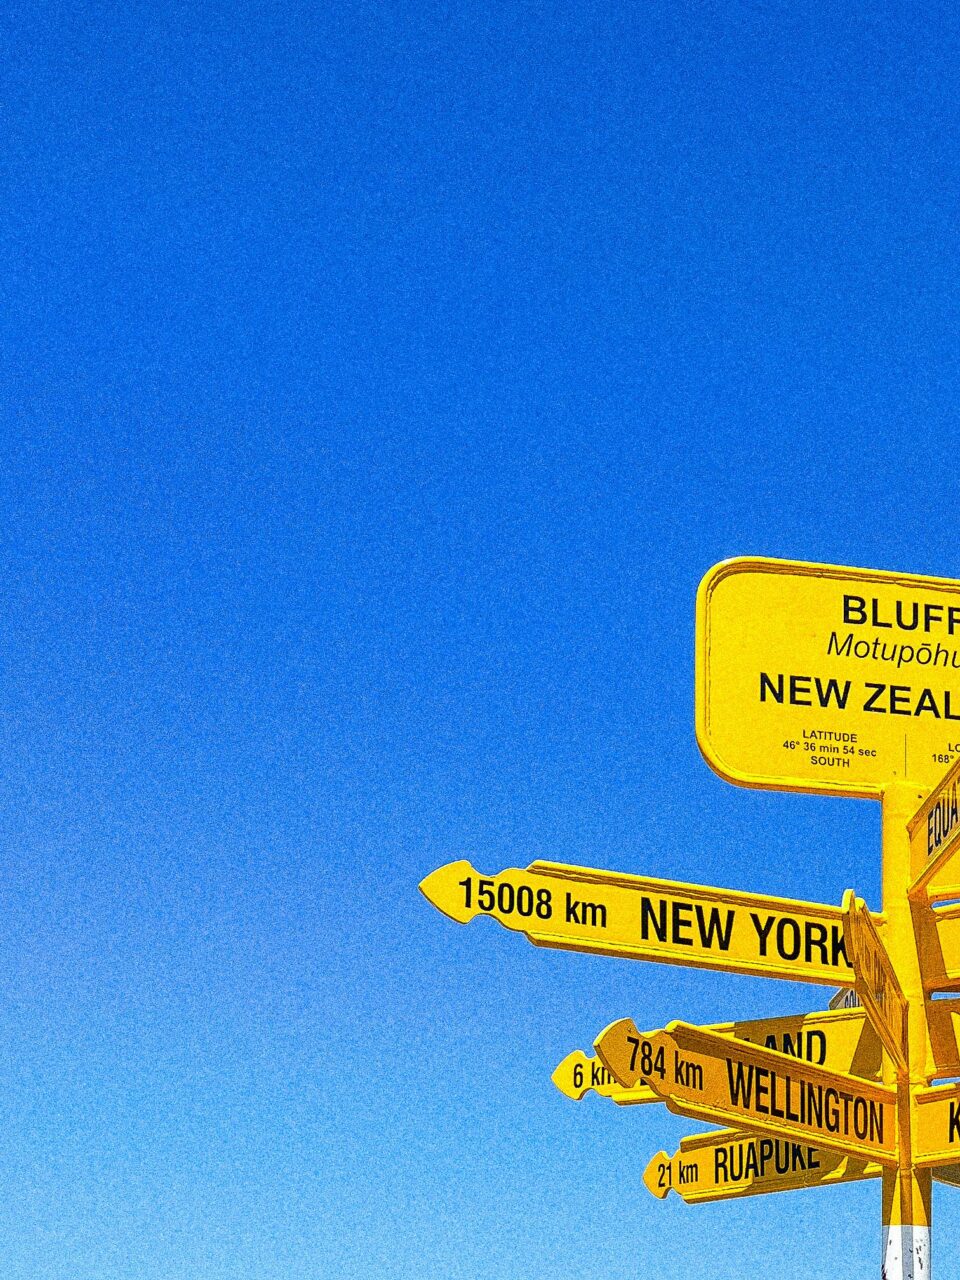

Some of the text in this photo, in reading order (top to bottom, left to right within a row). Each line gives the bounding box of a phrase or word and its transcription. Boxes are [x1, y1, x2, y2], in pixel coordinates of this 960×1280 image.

[759, 672, 852, 709] NEW
[783, 740, 877, 757] 46° 36 min 54 sec
[803, 729, 858, 743] LATITUDE
[810, 755, 850, 768] SOUTH
[459, 877, 553, 920] 15008
[565, 892, 607, 928] km
[640, 896, 735, 951] NEW
[750, 912, 854, 969] YORK
[573, 1063, 583, 1088] 6
[626, 1035, 884, 1144] 784 km WELLINGTON
[657, 1138, 821, 1188] 21 km RUAPUKE
